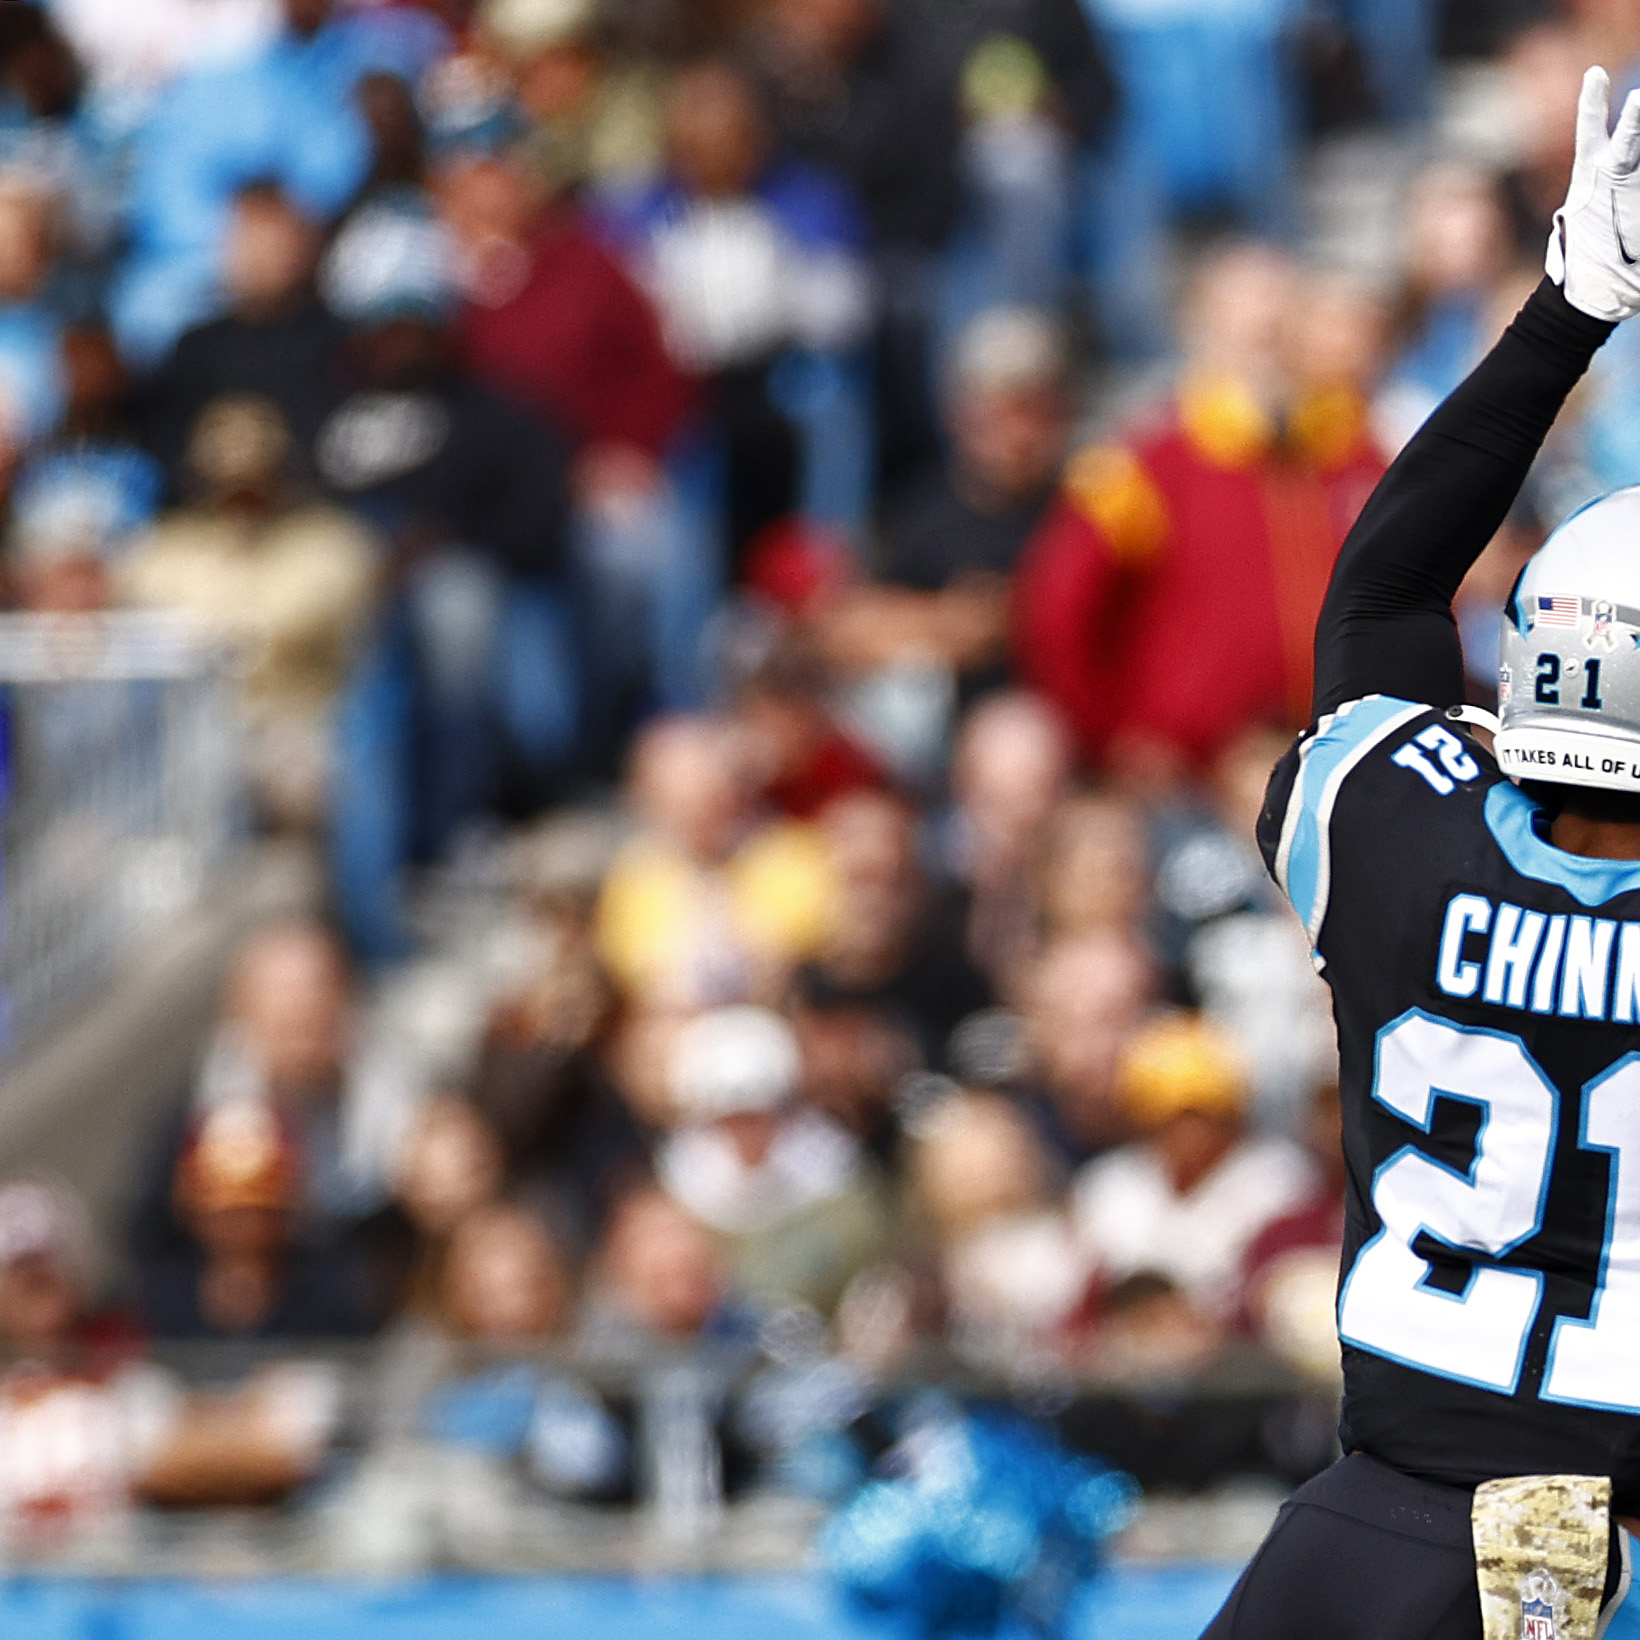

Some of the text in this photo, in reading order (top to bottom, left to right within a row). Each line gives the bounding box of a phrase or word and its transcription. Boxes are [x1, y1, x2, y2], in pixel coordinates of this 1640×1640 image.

[1390, 722, 1482, 796] 21
[1514, 749, 1556, 765] TAKES
[1562, 752, 1594, 770] ALL
[1601, 758, 1626, 775] OF
[1525, 1616, 1554, 1640] NFL
